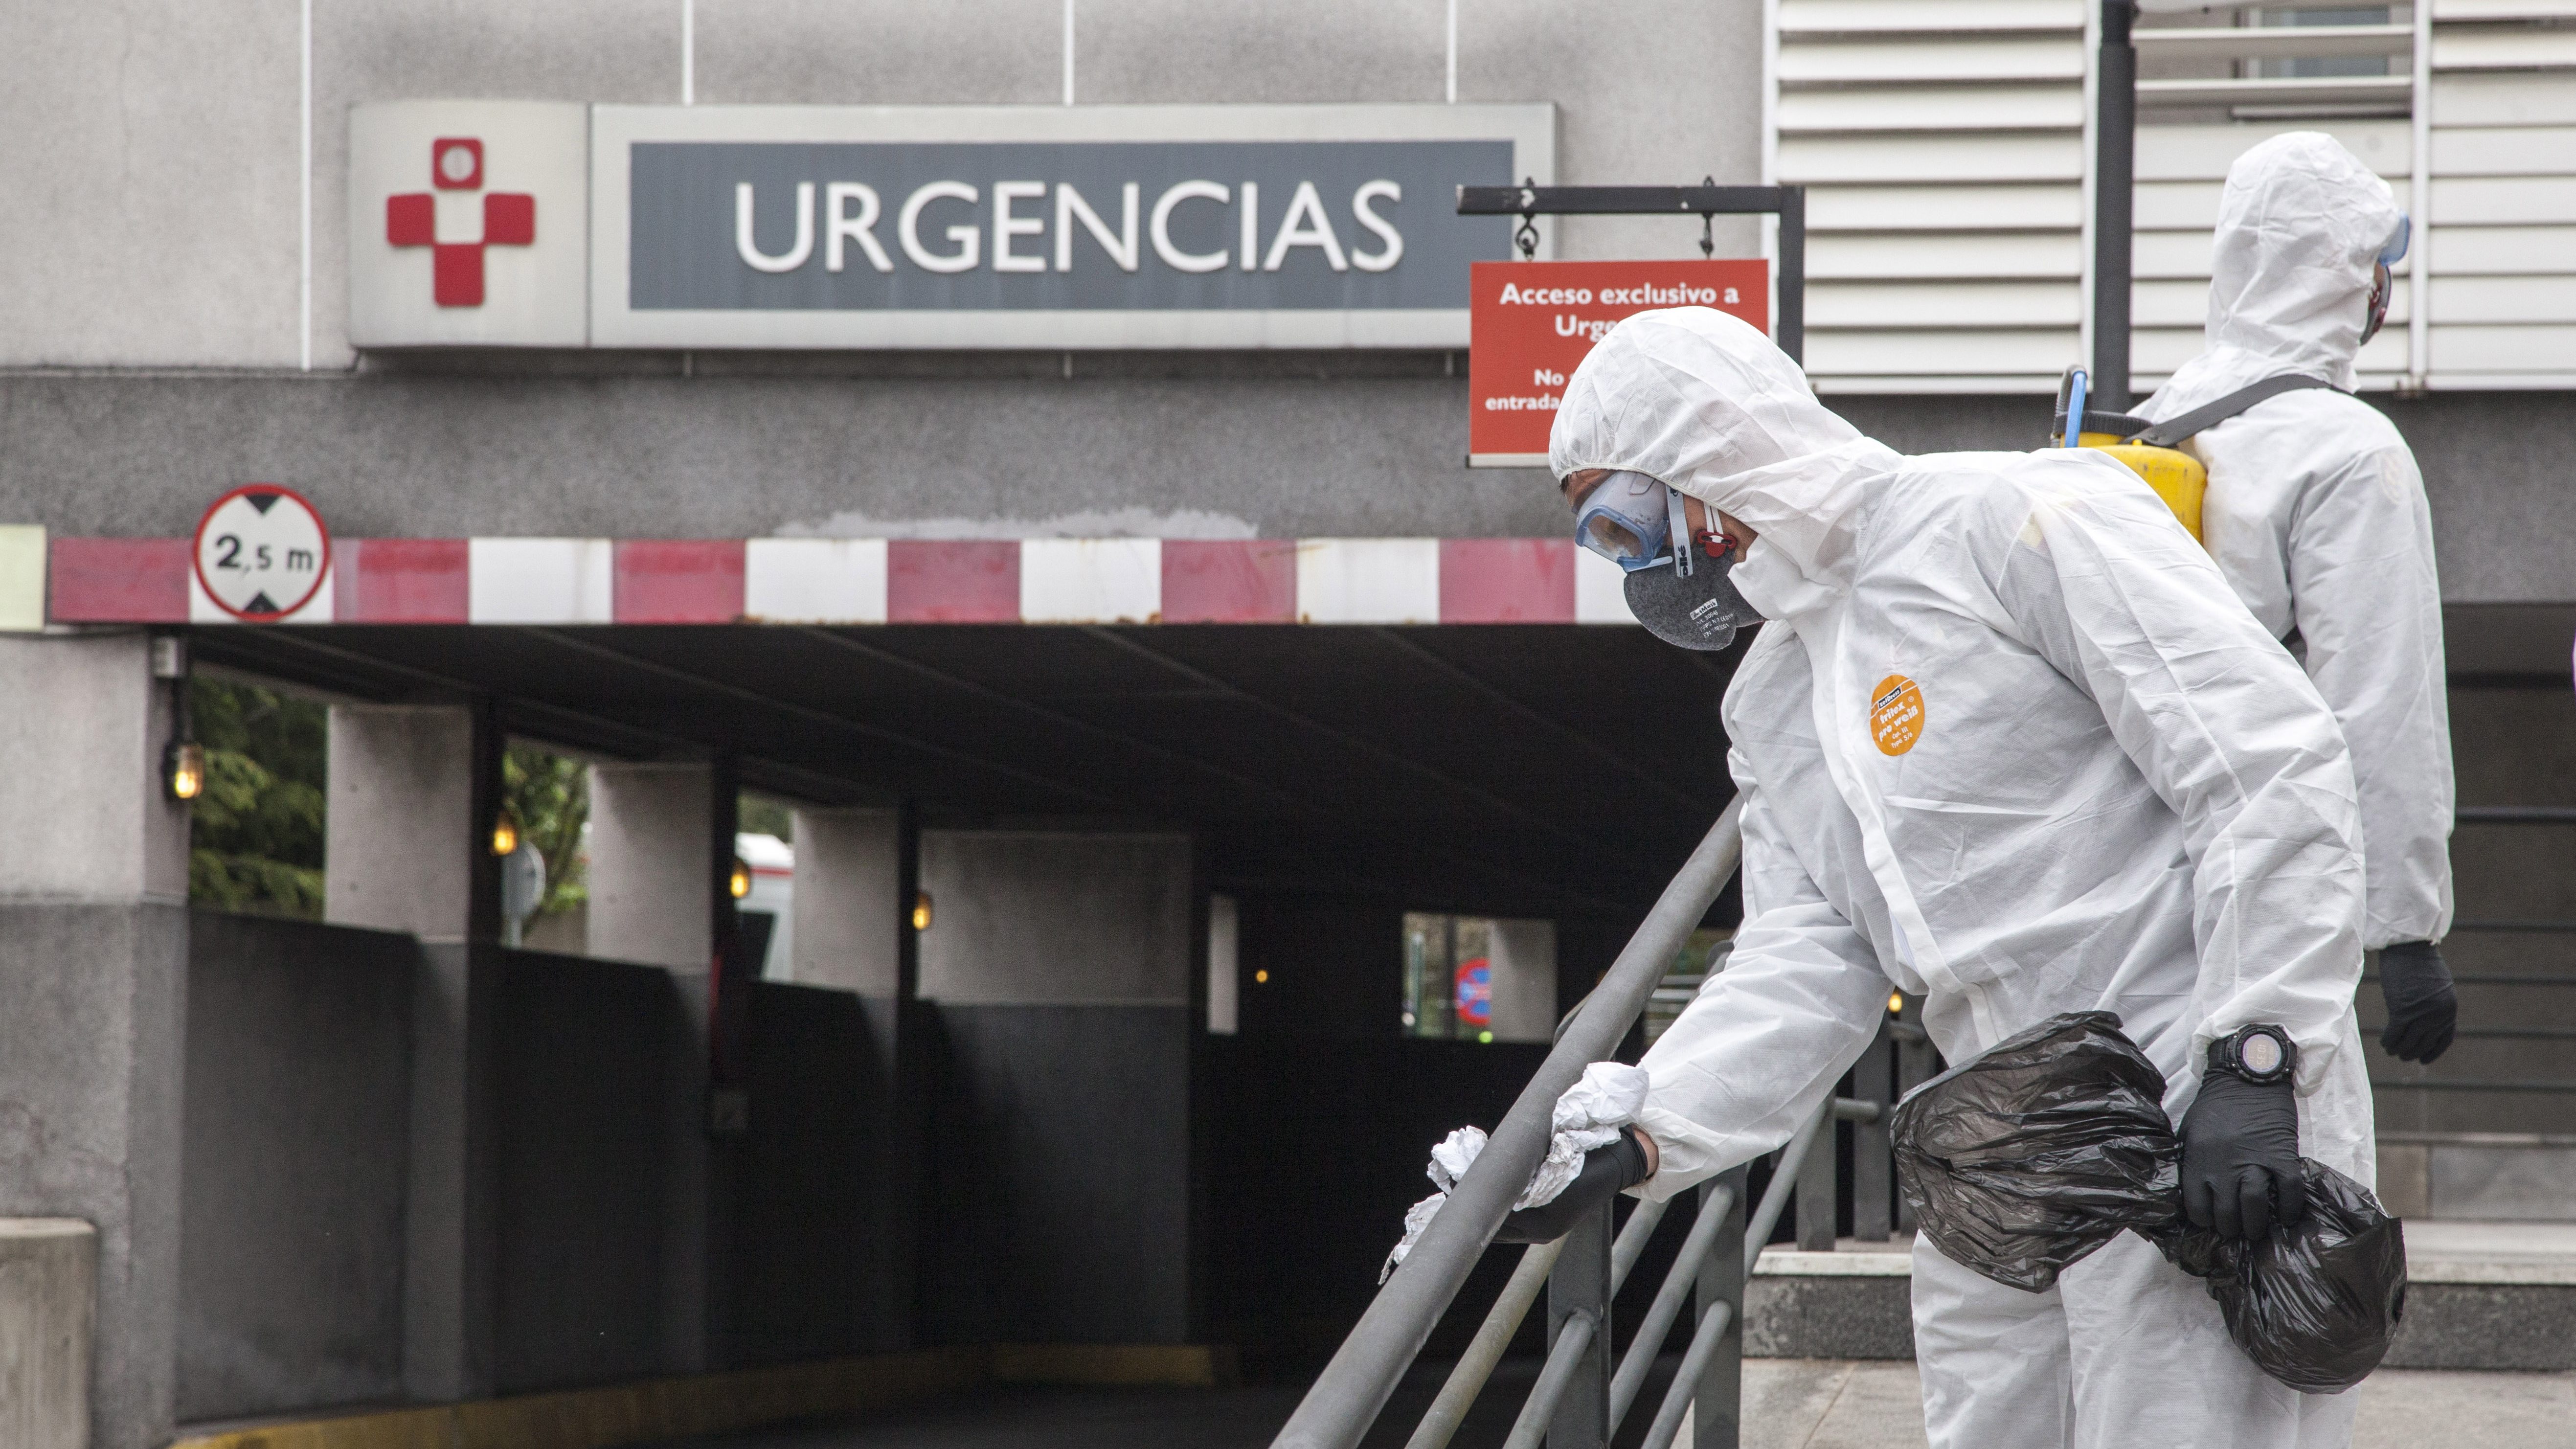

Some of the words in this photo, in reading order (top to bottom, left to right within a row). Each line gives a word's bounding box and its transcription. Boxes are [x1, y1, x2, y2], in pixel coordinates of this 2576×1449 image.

[735, 180, 1404, 273] URGENCIAS
[1499, 283, 1593, 305] Acceso
[1600, 282, 1717, 305] exclusivo
[1724, 287, 1740, 304] a
[1534, 369, 1564, 386] No
[1485, 392, 1561, 410] entrada
[215, 532, 272, 575] 2,5
[287, 548, 314, 571] m
[1879, 724, 1892, 742] pro
